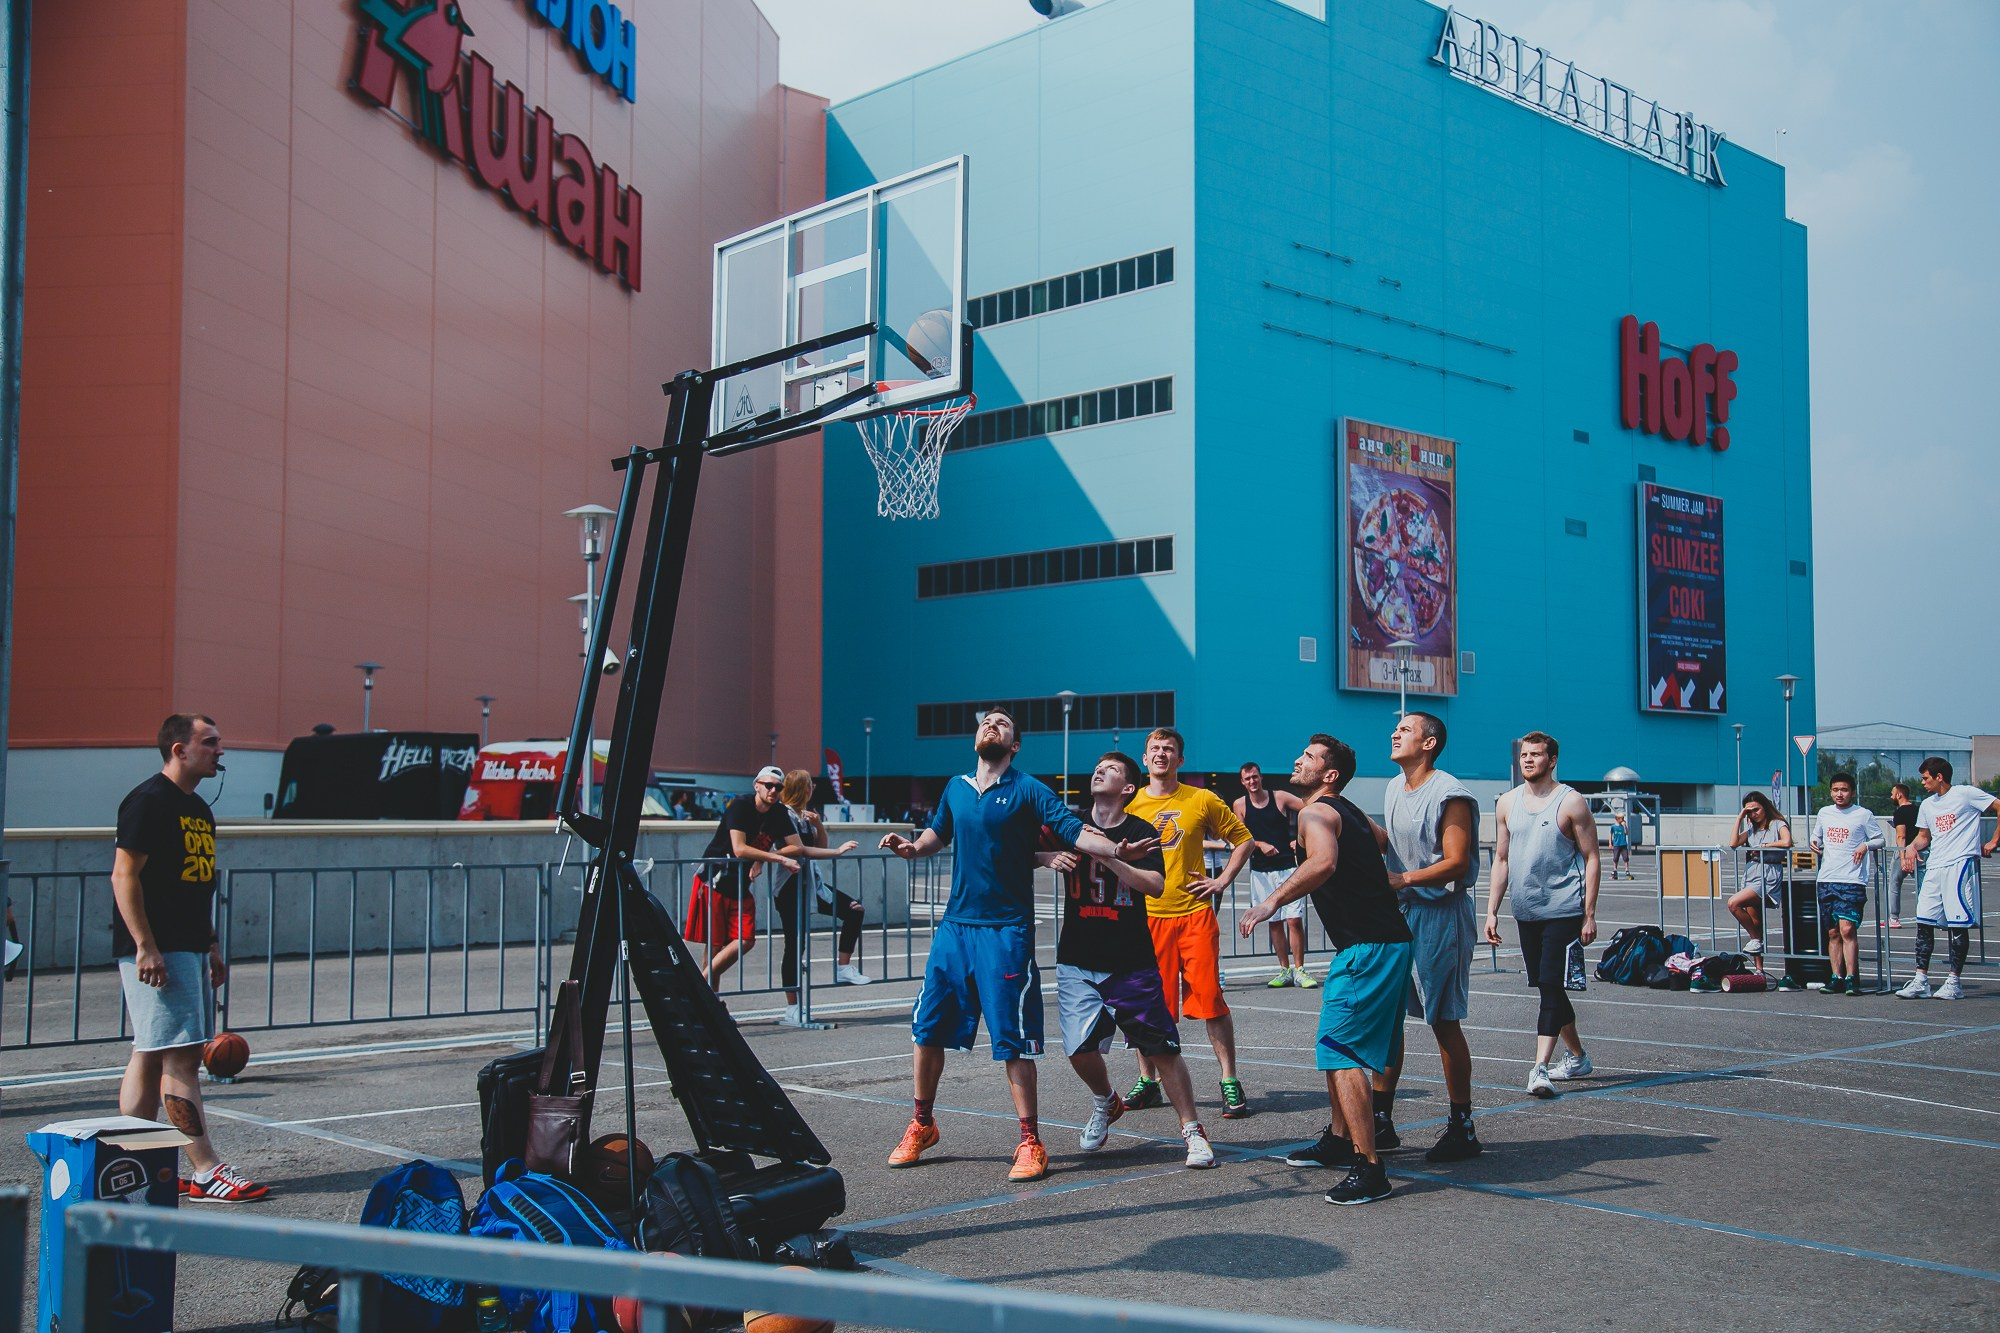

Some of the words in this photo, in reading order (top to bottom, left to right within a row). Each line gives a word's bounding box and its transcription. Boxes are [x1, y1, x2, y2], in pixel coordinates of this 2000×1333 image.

[1432, 4, 1729, 187] АВИАПАРК
[1661, 494, 1690, 513] SUMMER
[1691, 500, 1704, 515] JAM
[1651, 533, 1719, 575] SLIMZEE
[1669, 585, 1705, 620] COKI
